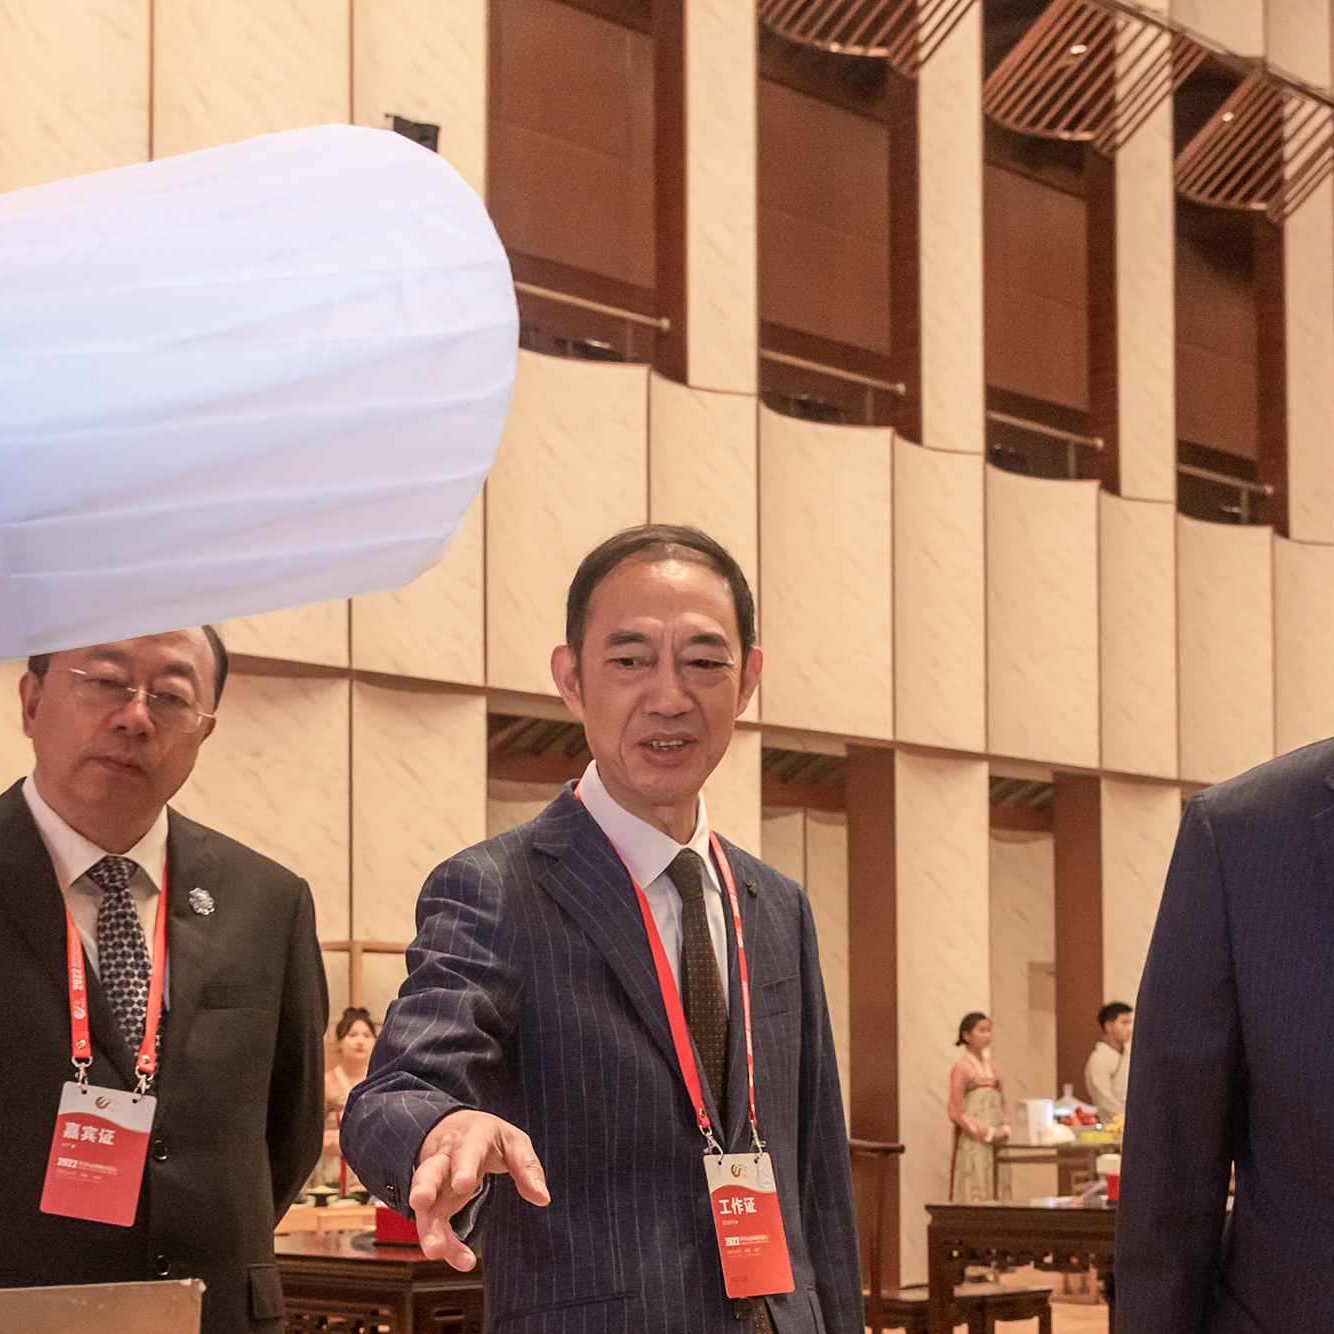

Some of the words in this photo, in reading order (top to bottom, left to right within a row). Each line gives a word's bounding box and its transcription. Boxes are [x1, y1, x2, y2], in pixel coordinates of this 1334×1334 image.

[72, 968, 84, 991] 2022
[63, 1121, 116, 1146] 嘉宾证
[719, 1197, 757, 1215] 工作证
